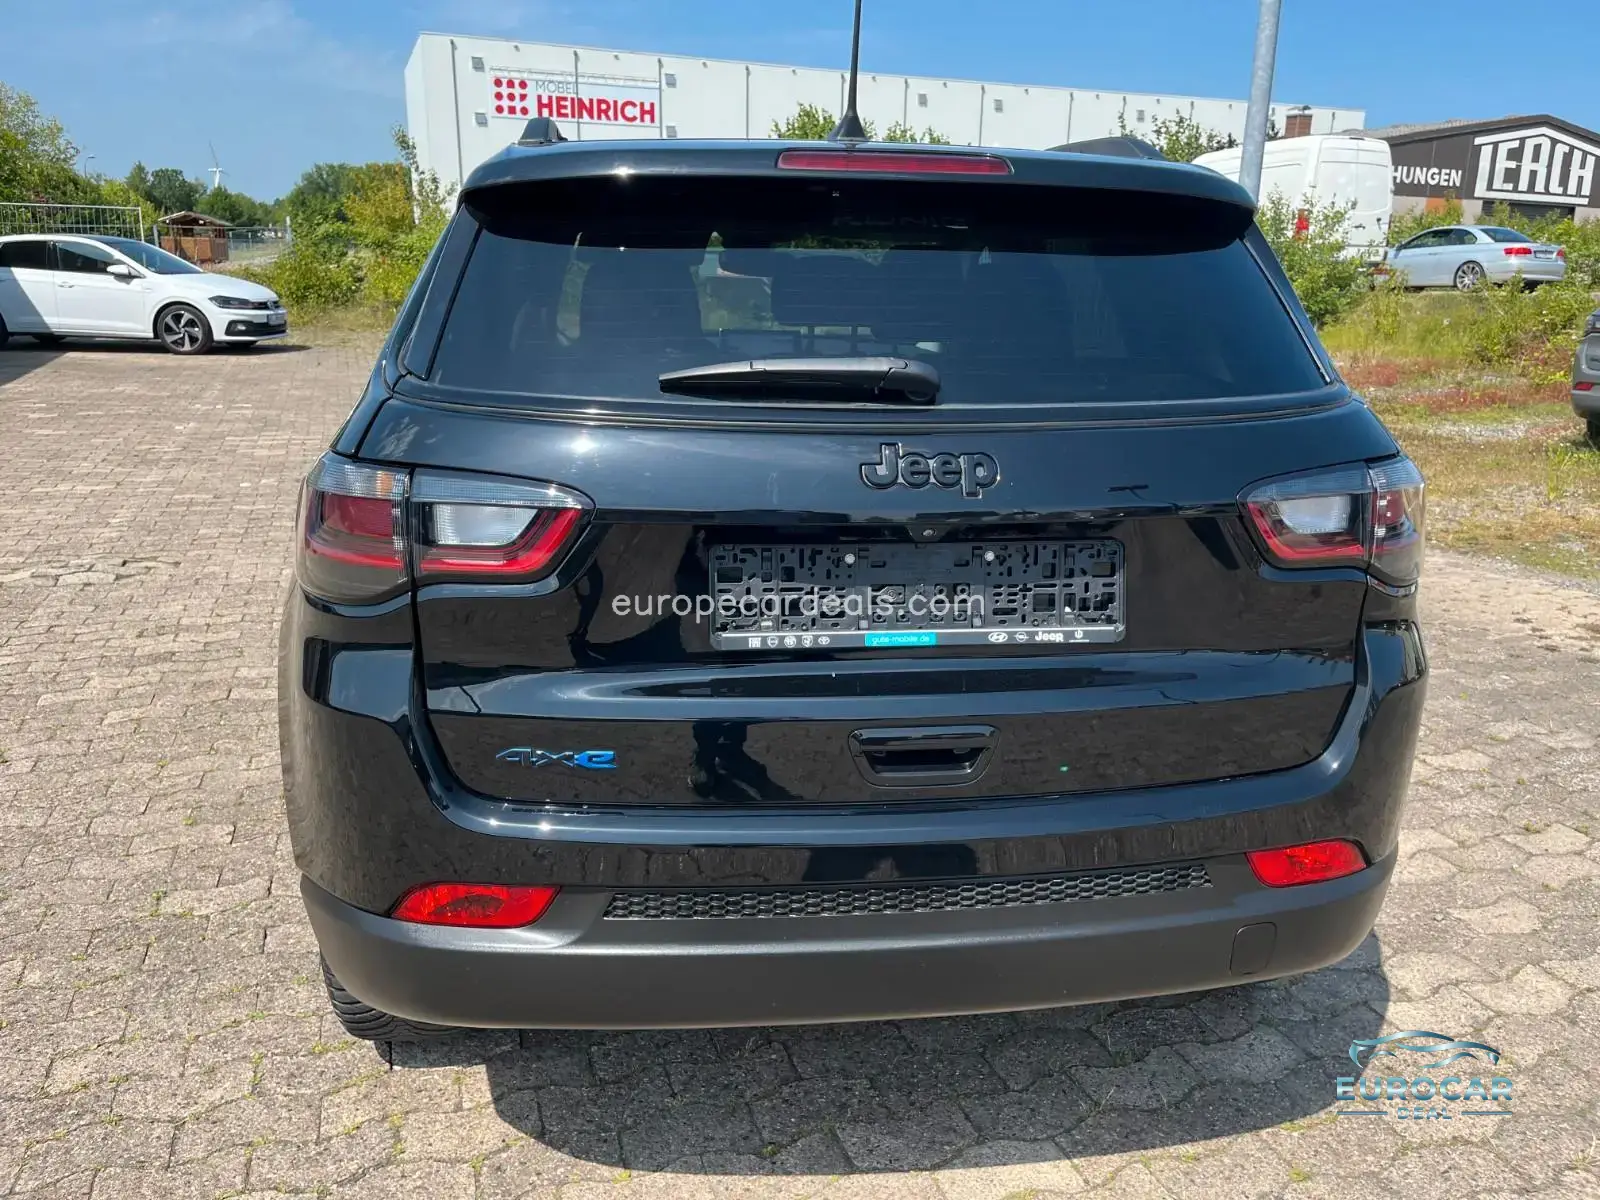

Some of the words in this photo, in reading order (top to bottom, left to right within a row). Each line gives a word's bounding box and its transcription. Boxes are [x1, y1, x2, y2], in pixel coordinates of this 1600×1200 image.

[537, 94, 656, 124] HEINRICH
[1474, 135, 1596, 205] LEACH
[860, 442, 1001, 499] Jeep
[1034, 631, 1064, 642] Jeep
